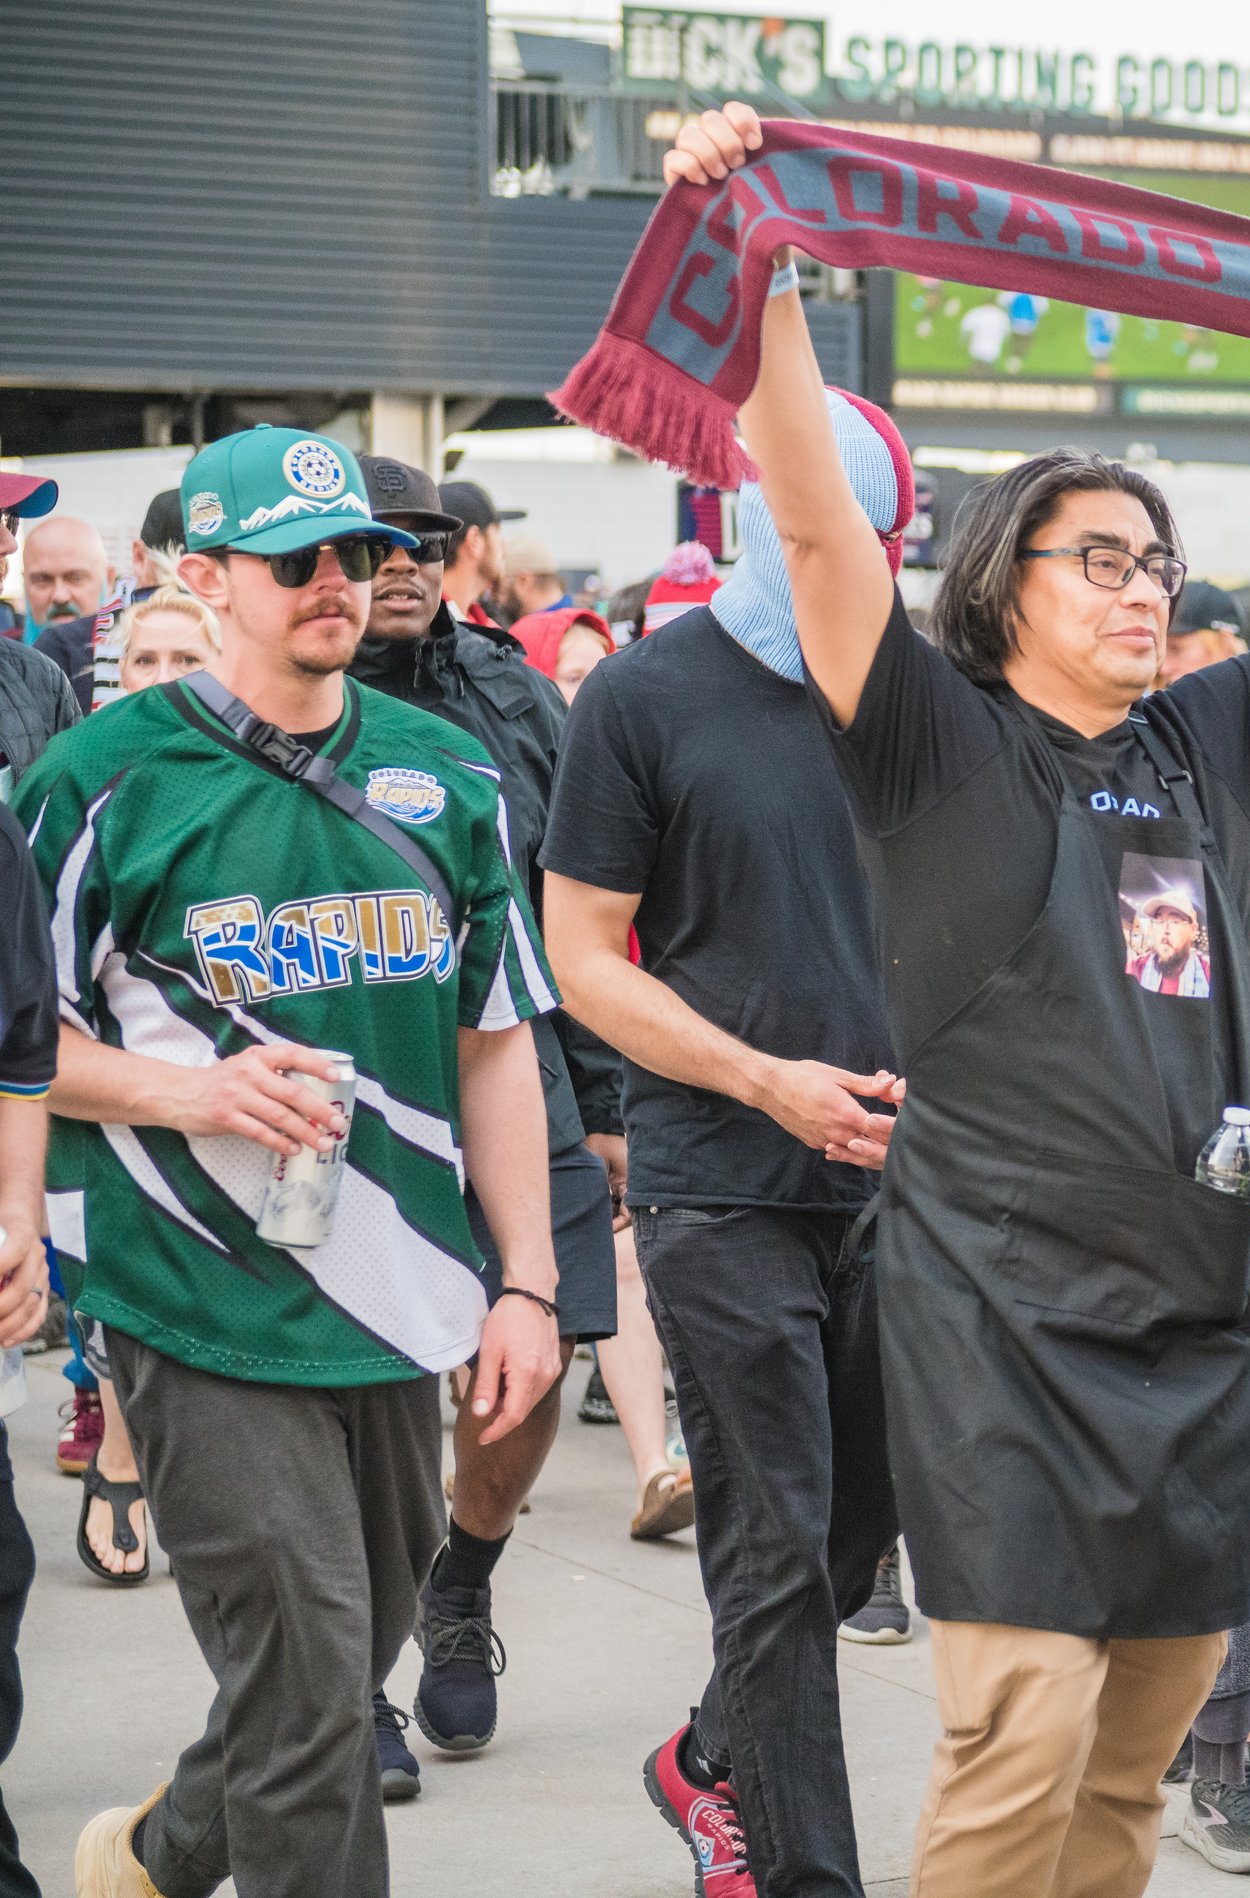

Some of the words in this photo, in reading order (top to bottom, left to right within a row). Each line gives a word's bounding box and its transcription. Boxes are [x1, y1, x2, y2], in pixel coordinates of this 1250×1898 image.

[843, 36, 1097, 112] SPORTING
[369, 783, 445, 809] RAPIDS
[371, 769, 435, 784] COLORADO
[183, 889, 455, 1008] RAPIDS
